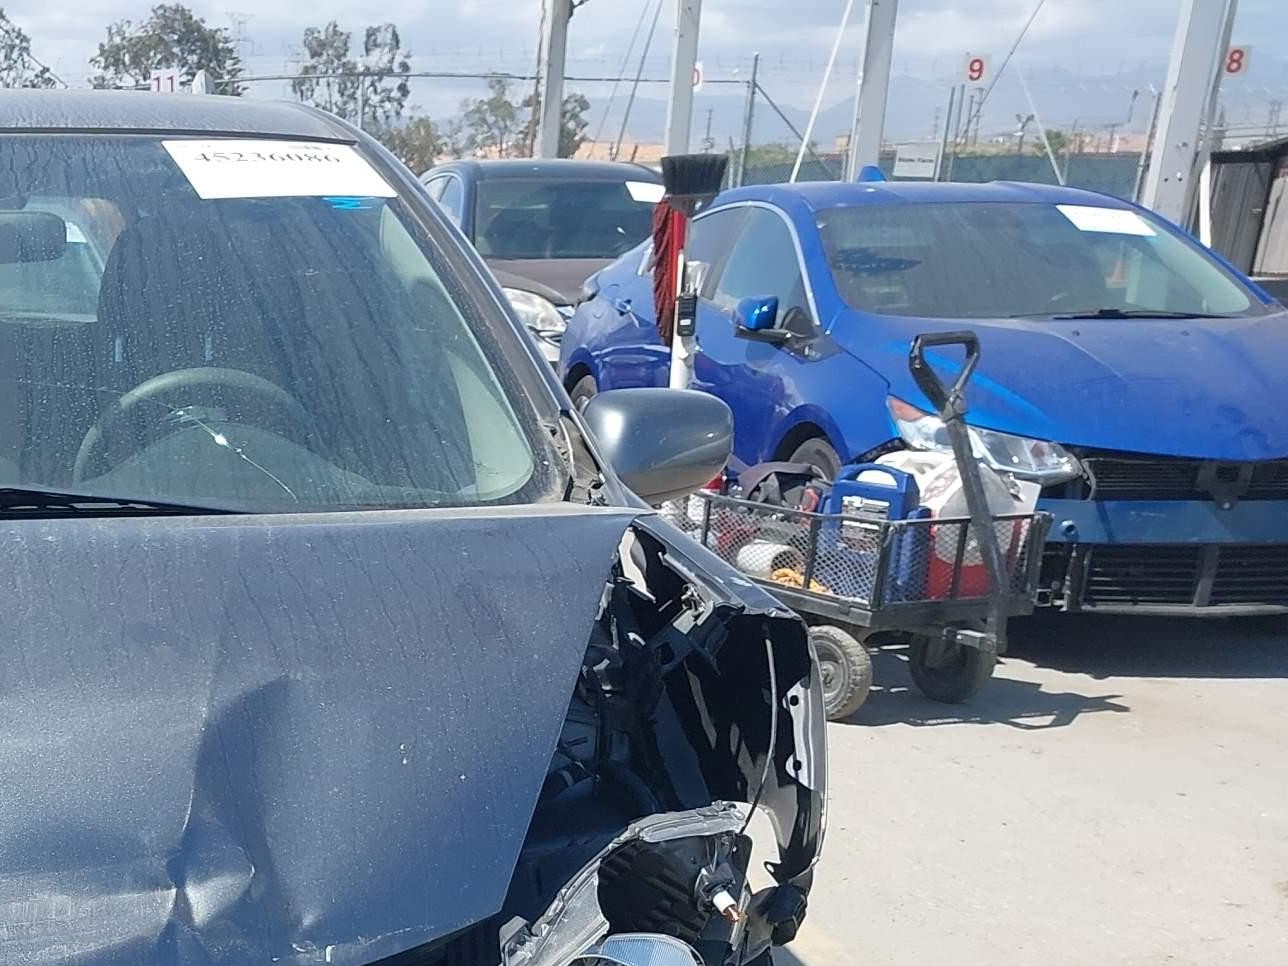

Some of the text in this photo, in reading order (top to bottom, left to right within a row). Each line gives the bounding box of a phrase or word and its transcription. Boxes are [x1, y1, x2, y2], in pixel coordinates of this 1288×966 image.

[969, 58, 984, 81] 9
[1226, 49, 1244, 73] 8
[153, 75, 174, 93] 11
[195, 151, 342, 164] 45236086
